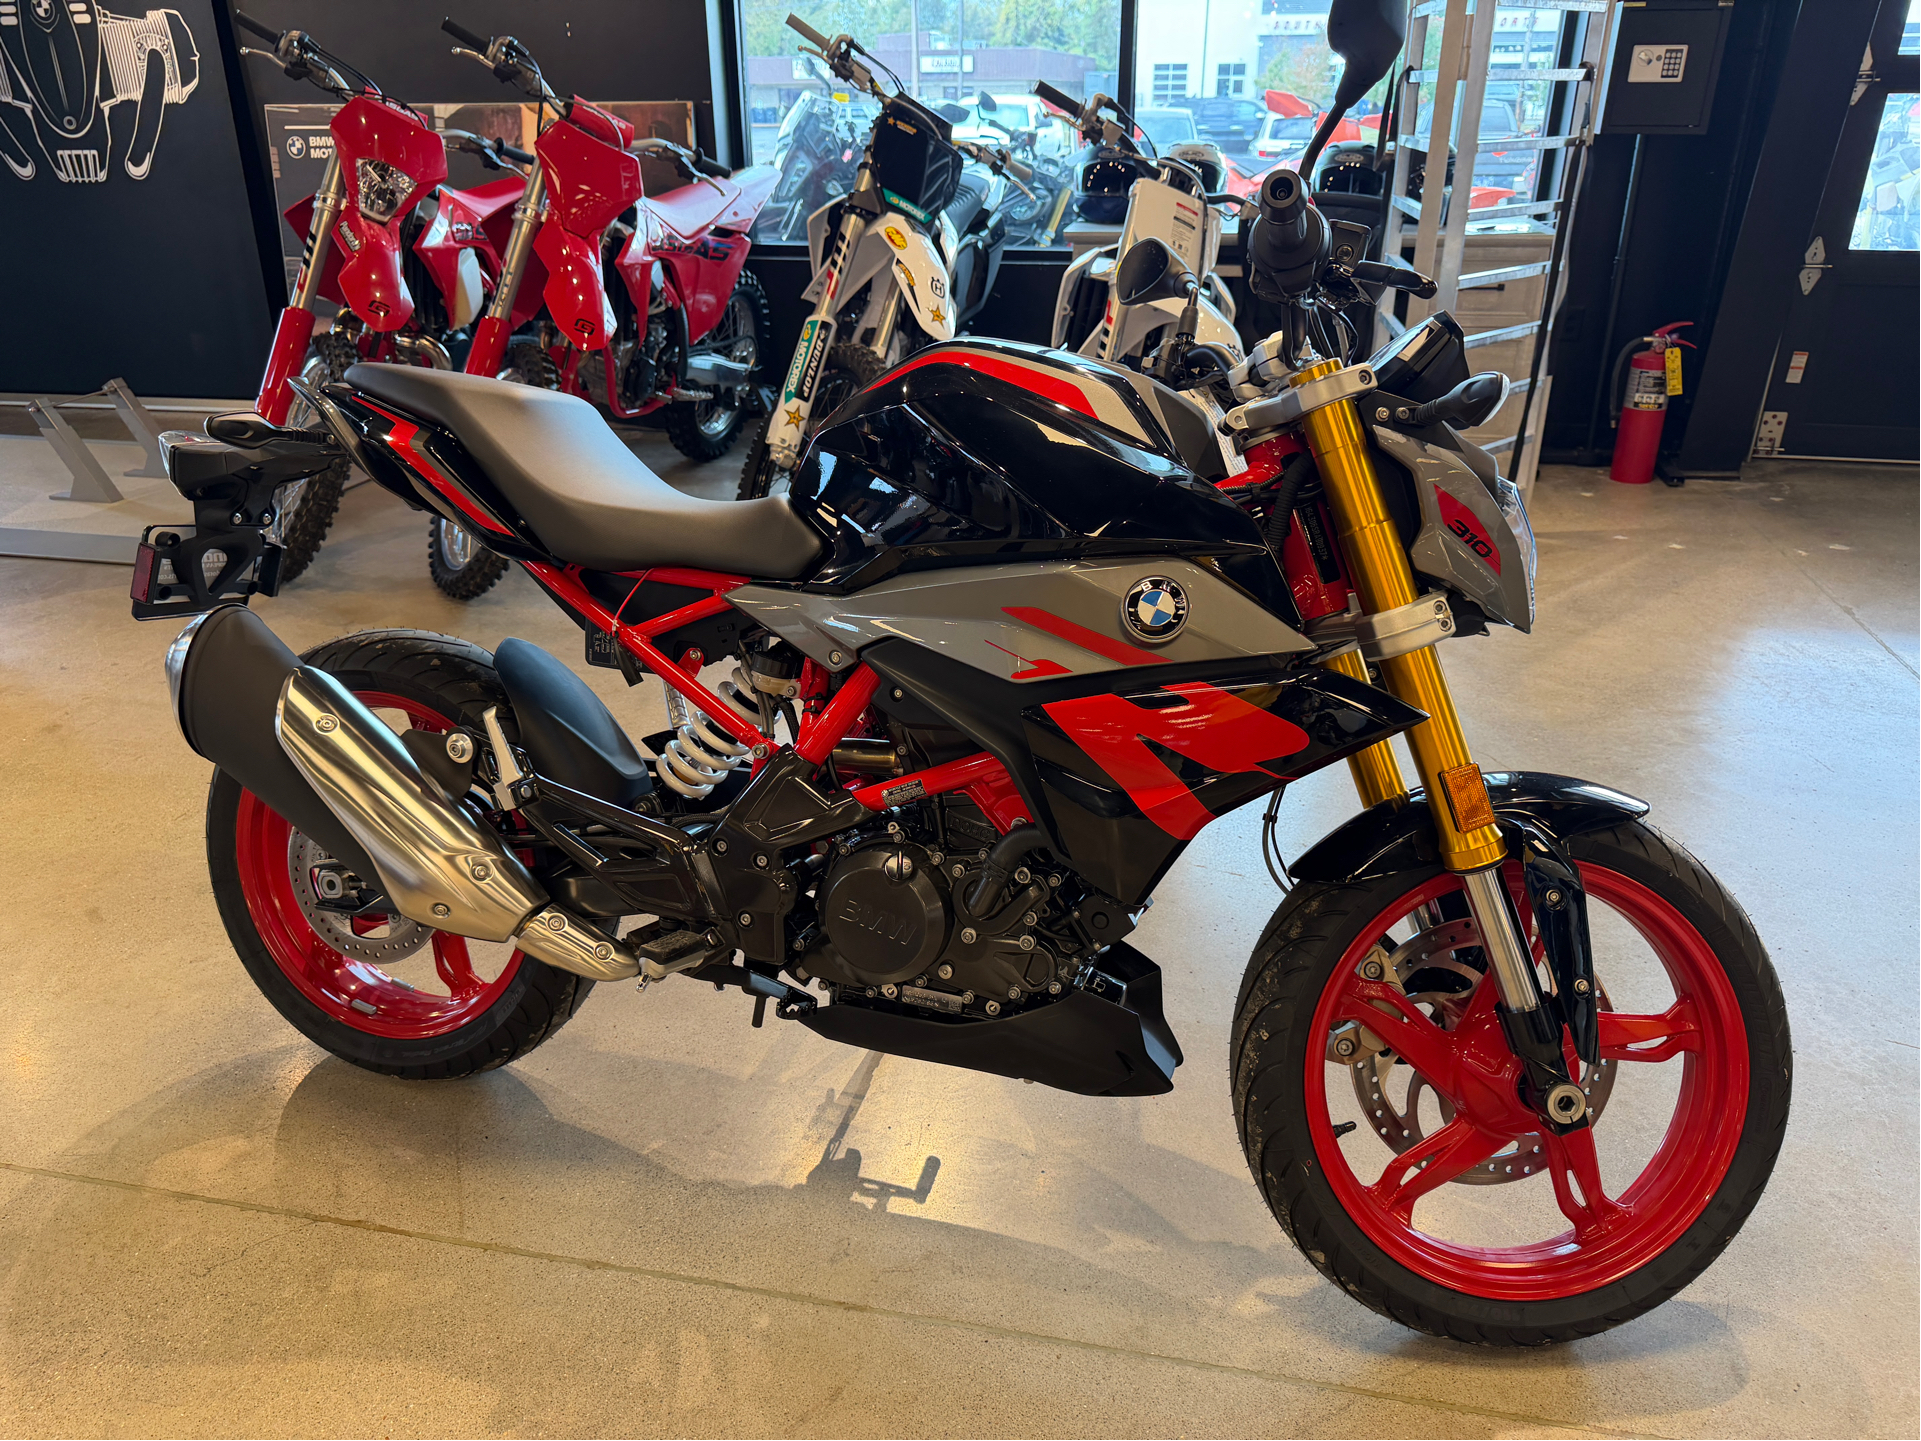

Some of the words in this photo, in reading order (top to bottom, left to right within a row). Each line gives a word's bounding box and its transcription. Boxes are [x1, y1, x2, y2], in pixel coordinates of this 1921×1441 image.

[309, 136, 335, 147] BMW
[899, 200, 926, 221] MOTOREX
[786, 341, 809, 393] MOTOREX
[803, 340, 824, 398] DUNLOP
[1447, 519, 1493, 558] 310
[839, 899, 918, 946] BMW
